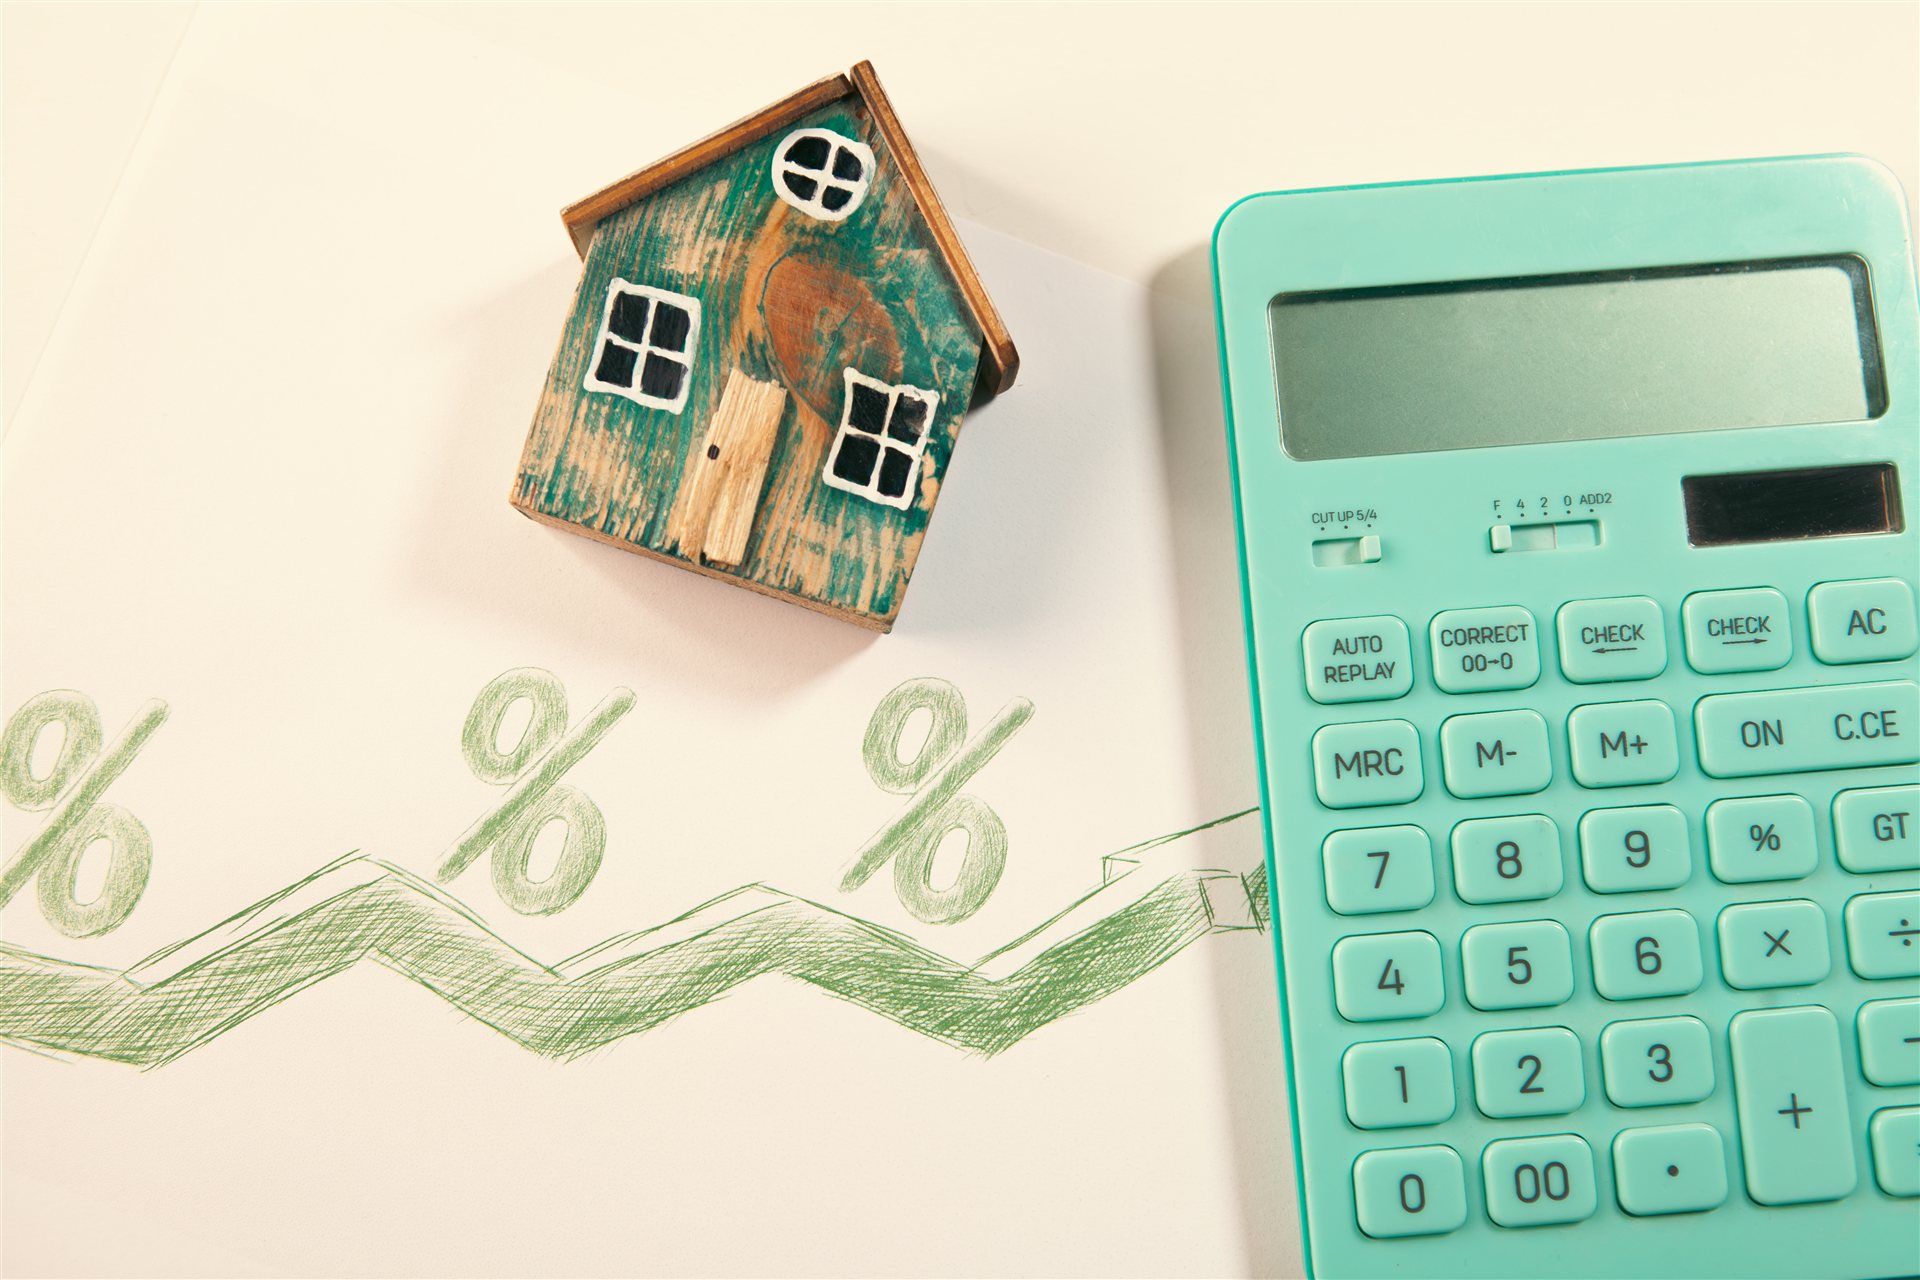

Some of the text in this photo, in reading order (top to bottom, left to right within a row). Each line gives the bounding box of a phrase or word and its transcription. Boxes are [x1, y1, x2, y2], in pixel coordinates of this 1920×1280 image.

[1311, 508, 1378, 524] CUT UP 5/4
[1493, 492, 1612, 511] F 4 2 0 ADD2
[1440, 624, 1529, 647] CORRECT
[1581, 623, 1645, 645] CHECK
[1707, 615, 1772, 637] CHECK
[1847, 607, 1887, 636] AC
[1332, 634, 1383, 656] AUTO
[1323, 661, 1396, 684] REPLAY
[1599, 730, 1649, 759] M+
[1740, 709, 1900, 749] ON C.CE
[1334, 747, 1405, 780] MRC
[1475, 739, 1518, 769] M-
[1873, 811, 1910, 842] GT
[1495, 840, 1523, 880] 8
[1624, 830, 1651, 869] 9
[1366, 850, 1391, 890] 7
[1507, 946, 1533, 985] 5
[1634, 936, 1663, 976] 6
[1377, 958, 1405, 996] 4
[1517, 1054, 1545, 1095] 2
[1647, 1043, 1674, 1083] 3
[1393, 1065, 1409, 1104] 1
[1399, 1173, 1426, 1214] 0
[1513, 1161, 1570, 1204] 00
